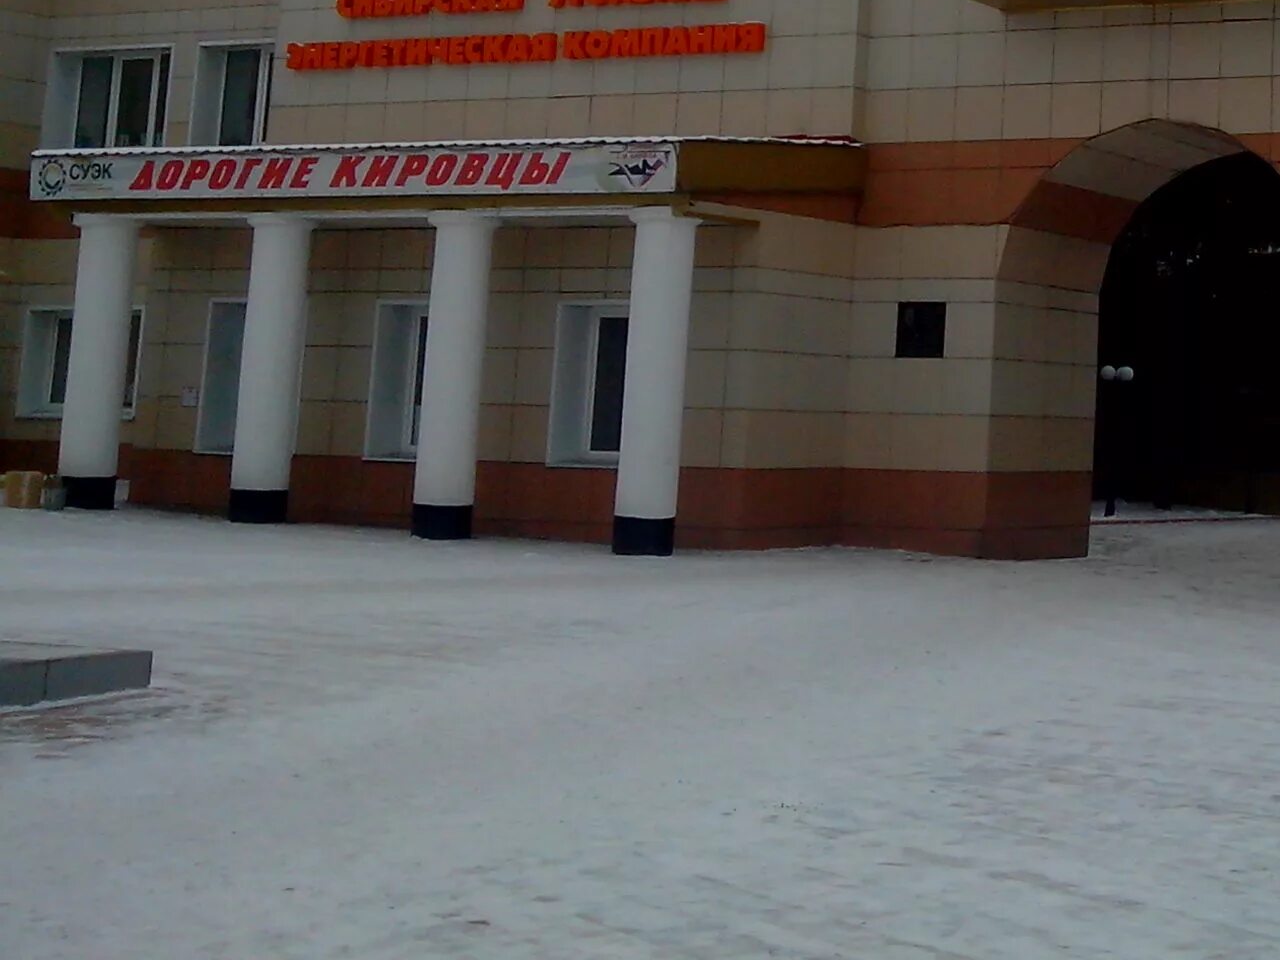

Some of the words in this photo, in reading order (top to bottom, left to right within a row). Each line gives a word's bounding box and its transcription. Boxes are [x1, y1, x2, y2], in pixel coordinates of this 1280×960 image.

[562, 22, 766, 60] КОМПАНИЯ
[68, 162, 112, 181] СУЭК
[128, 156, 320, 191] ДОРОГИЕ
[329, 152, 572, 191] КИРОВЦЫ
